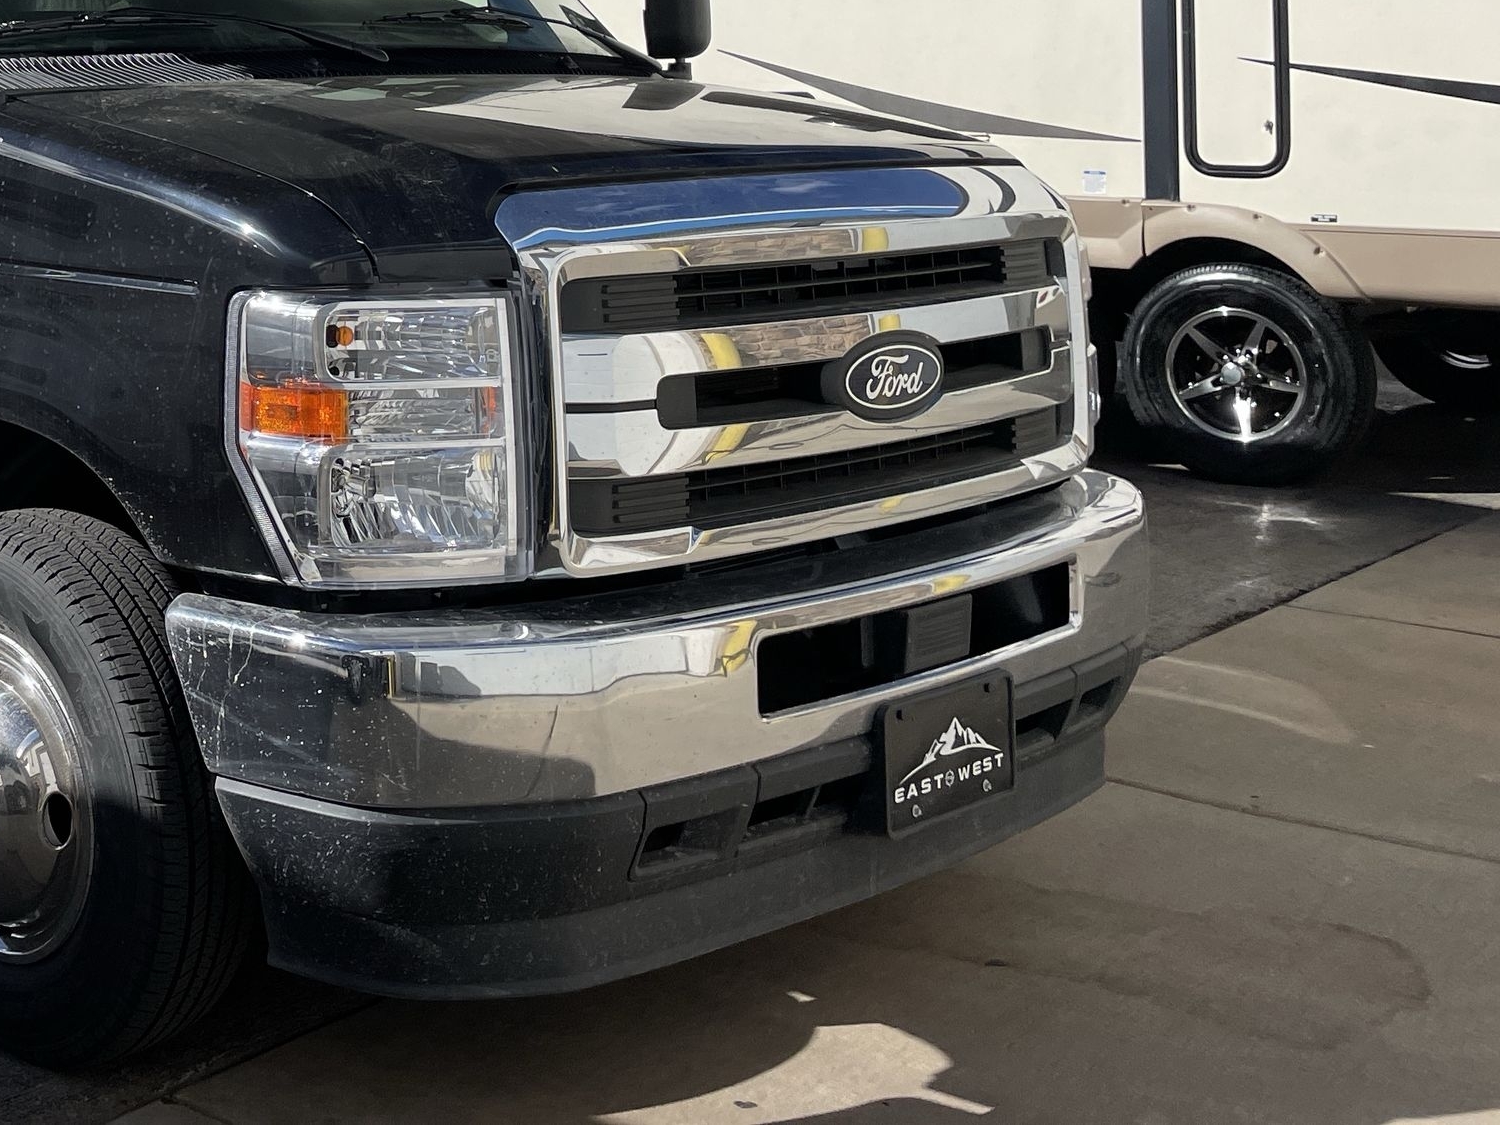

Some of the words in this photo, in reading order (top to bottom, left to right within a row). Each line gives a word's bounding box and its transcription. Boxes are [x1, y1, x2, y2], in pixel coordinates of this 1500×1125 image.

[866, 355, 923, 399] Ford
[894, 774, 944, 803] EAST
[958, 753, 1004, 782] WEST
